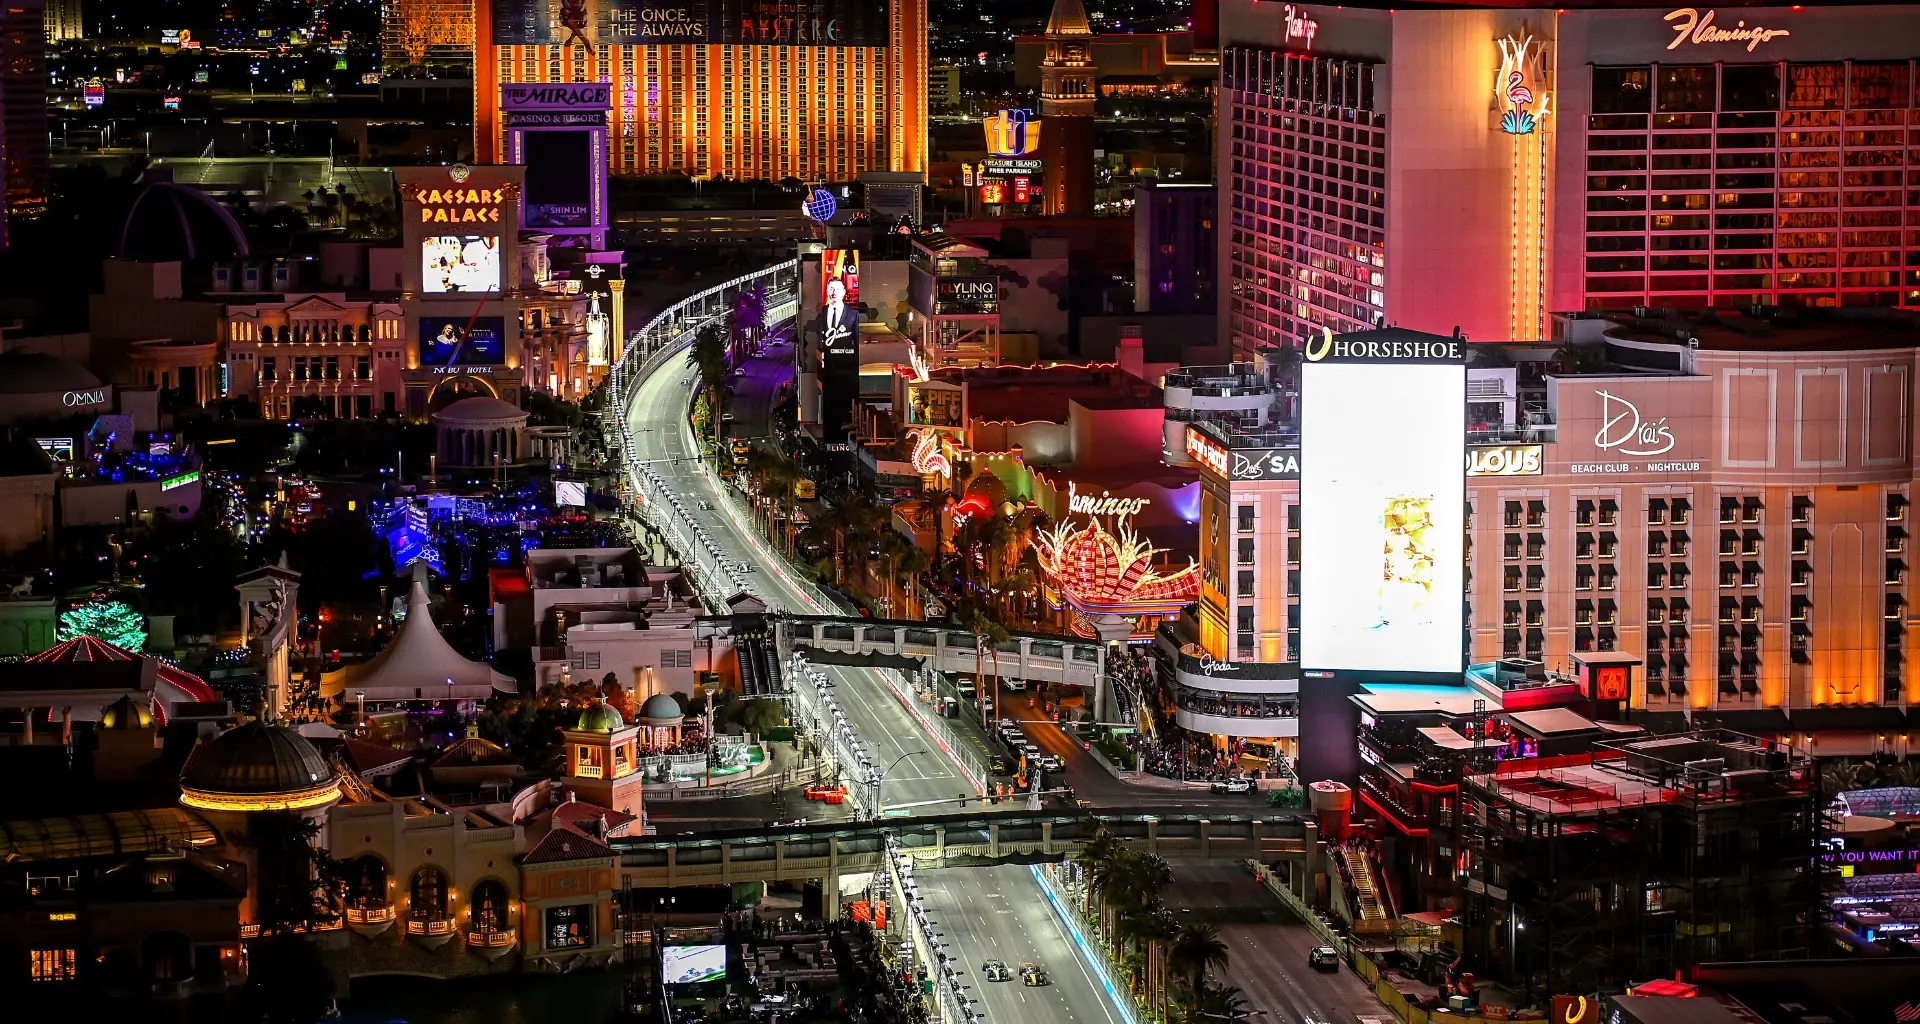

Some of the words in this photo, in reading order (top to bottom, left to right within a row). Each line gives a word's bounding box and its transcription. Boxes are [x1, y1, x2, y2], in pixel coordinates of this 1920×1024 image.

[610, 9, 637, 22] THE
[641, 9, 691, 23] ONCE,
[610, 24, 637, 36] THE
[641, 23, 703, 36] ALWAYS
[1284, 4, 1318, 51] Flamingo
[1663, 8, 1790, 52] Flamingo
[505, 88, 527, 99] THE
[526, 88, 607, 105] MIRAGE
[563, 114, 600, 122] RESORT
[416, 189, 503, 204] CAESARS
[422, 207, 499, 223] PALACE
[550, 206, 570, 214] SHIN
[62, 390, 105, 407] OMNIA
[928, 391, 961, 405] PIFF
[1594, 389, 1676, 456] Drai's
[1571, 465, 1602, 473] BEACH
[1605, 464, 1629, 472] CLUB
[1648, 463, 1700, 472] NIGHTCLUB
[1199, 653, 1240, 676] Giada
[1840, 851, 1865, 862] YOU
[1869, 850, 1904, 861] WANT
[1908, 850, 1919, 860] IT
